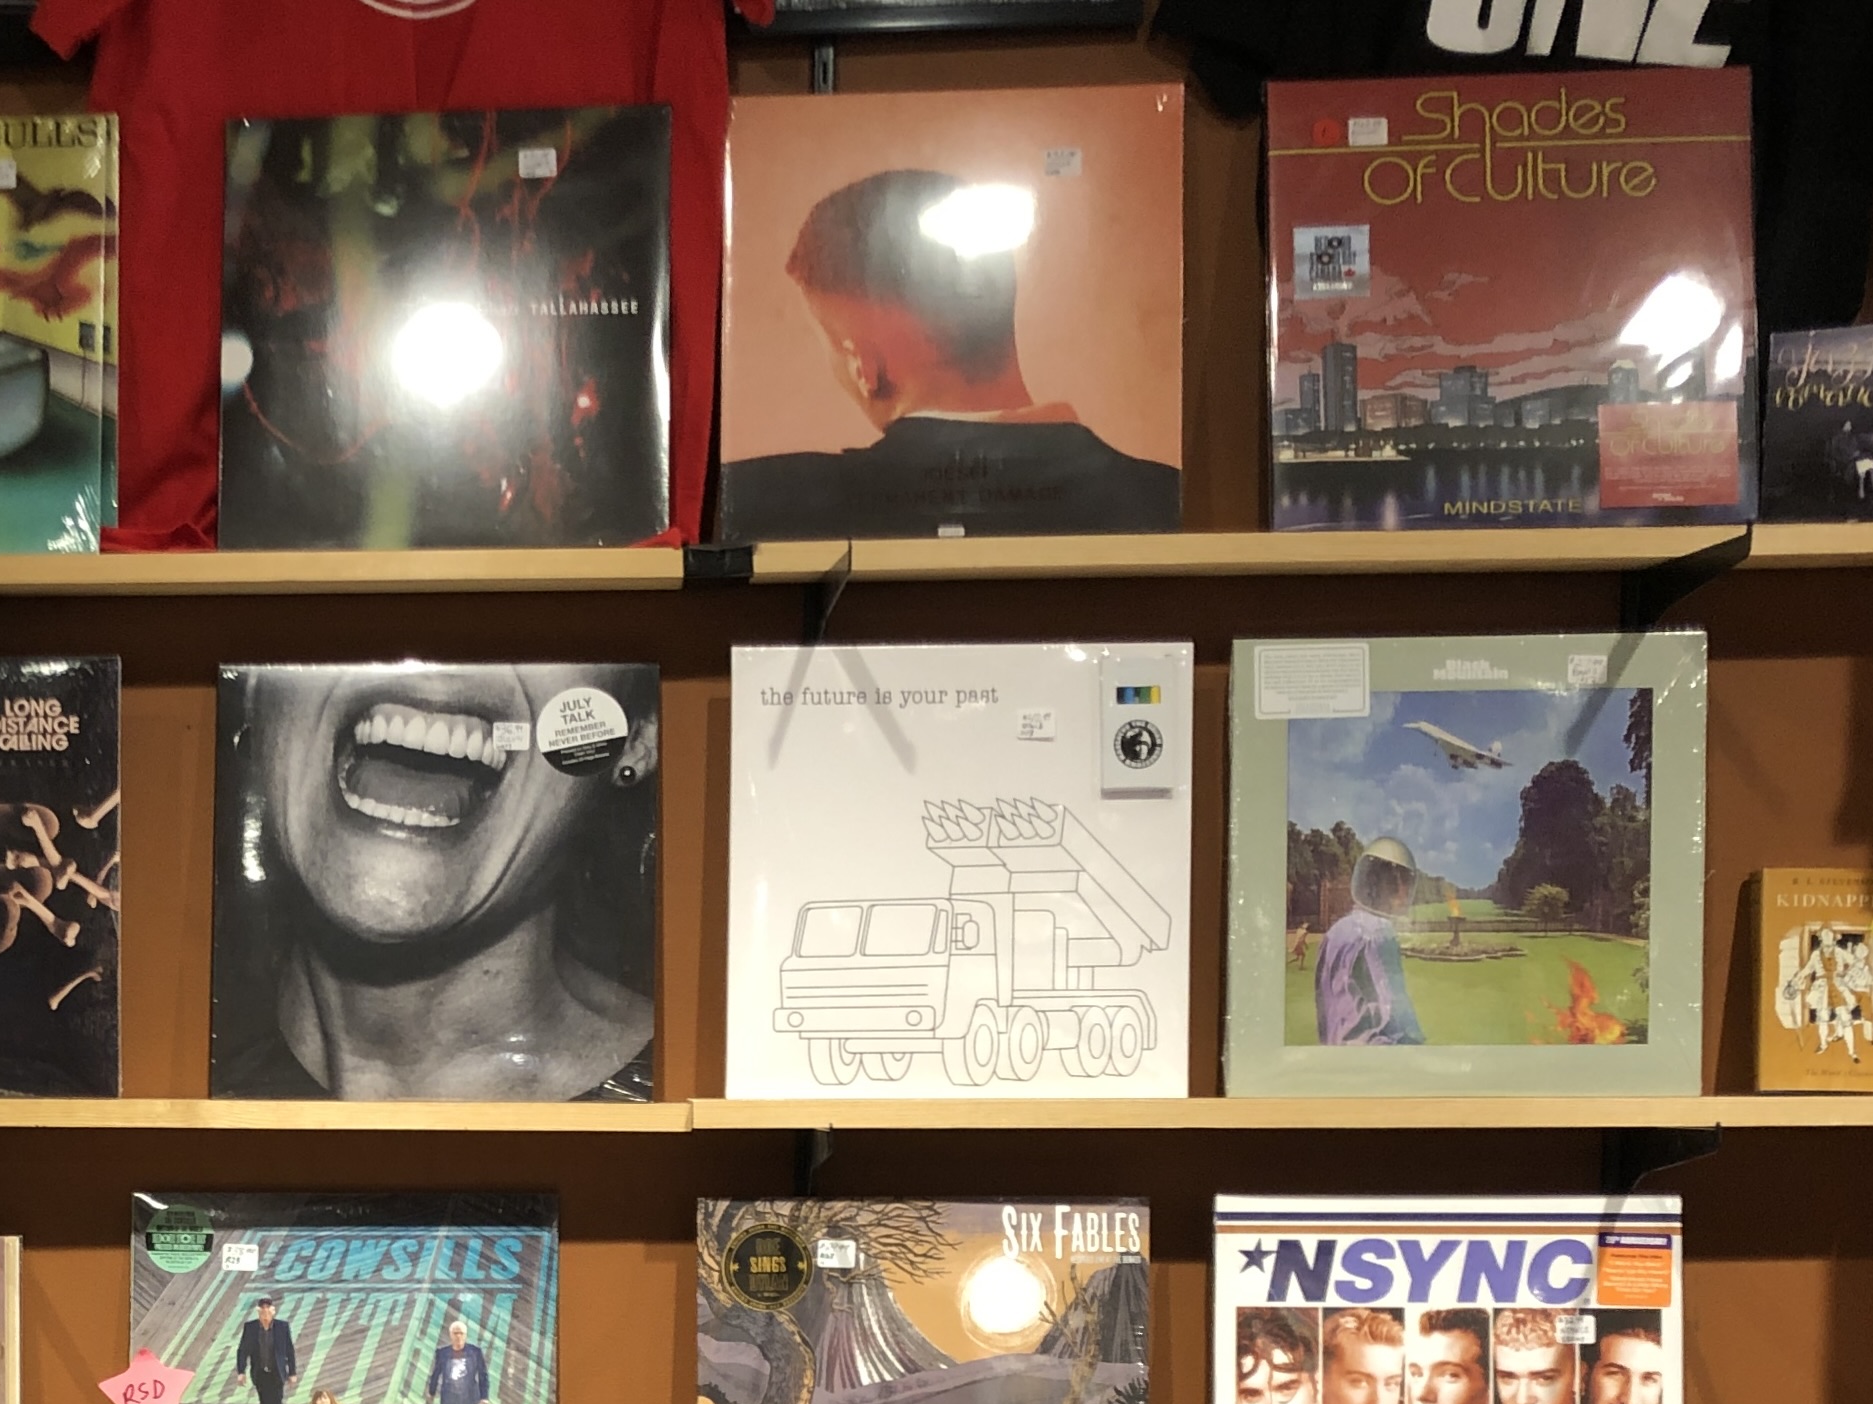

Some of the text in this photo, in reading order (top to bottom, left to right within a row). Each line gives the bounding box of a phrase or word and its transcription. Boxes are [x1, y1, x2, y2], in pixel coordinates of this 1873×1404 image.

[1364, 148, 1658, 205] Of Culture
[530, 301, 639, 316] TALLAHASSEE
[1443, 498, 1582, 515] MINDSTATE
[559, 697, 593, 713] JULY
[760, 687, 1000, 709] the future is your past
[4, 698, 62, 717] LONG
[561, 709, 596, 726] TALK
[548, 728, 616, 748] NEVER BEFORE
[554, 720, 607, 738] REMEMBER
[1776, 893, 1873, 908] KIDNAPP
[1054, 1205, 1141, 1259] FABLES
[274, 1237, 523, 1281] COWSILLS
[749, 1258, 787, 1273] SINGS
